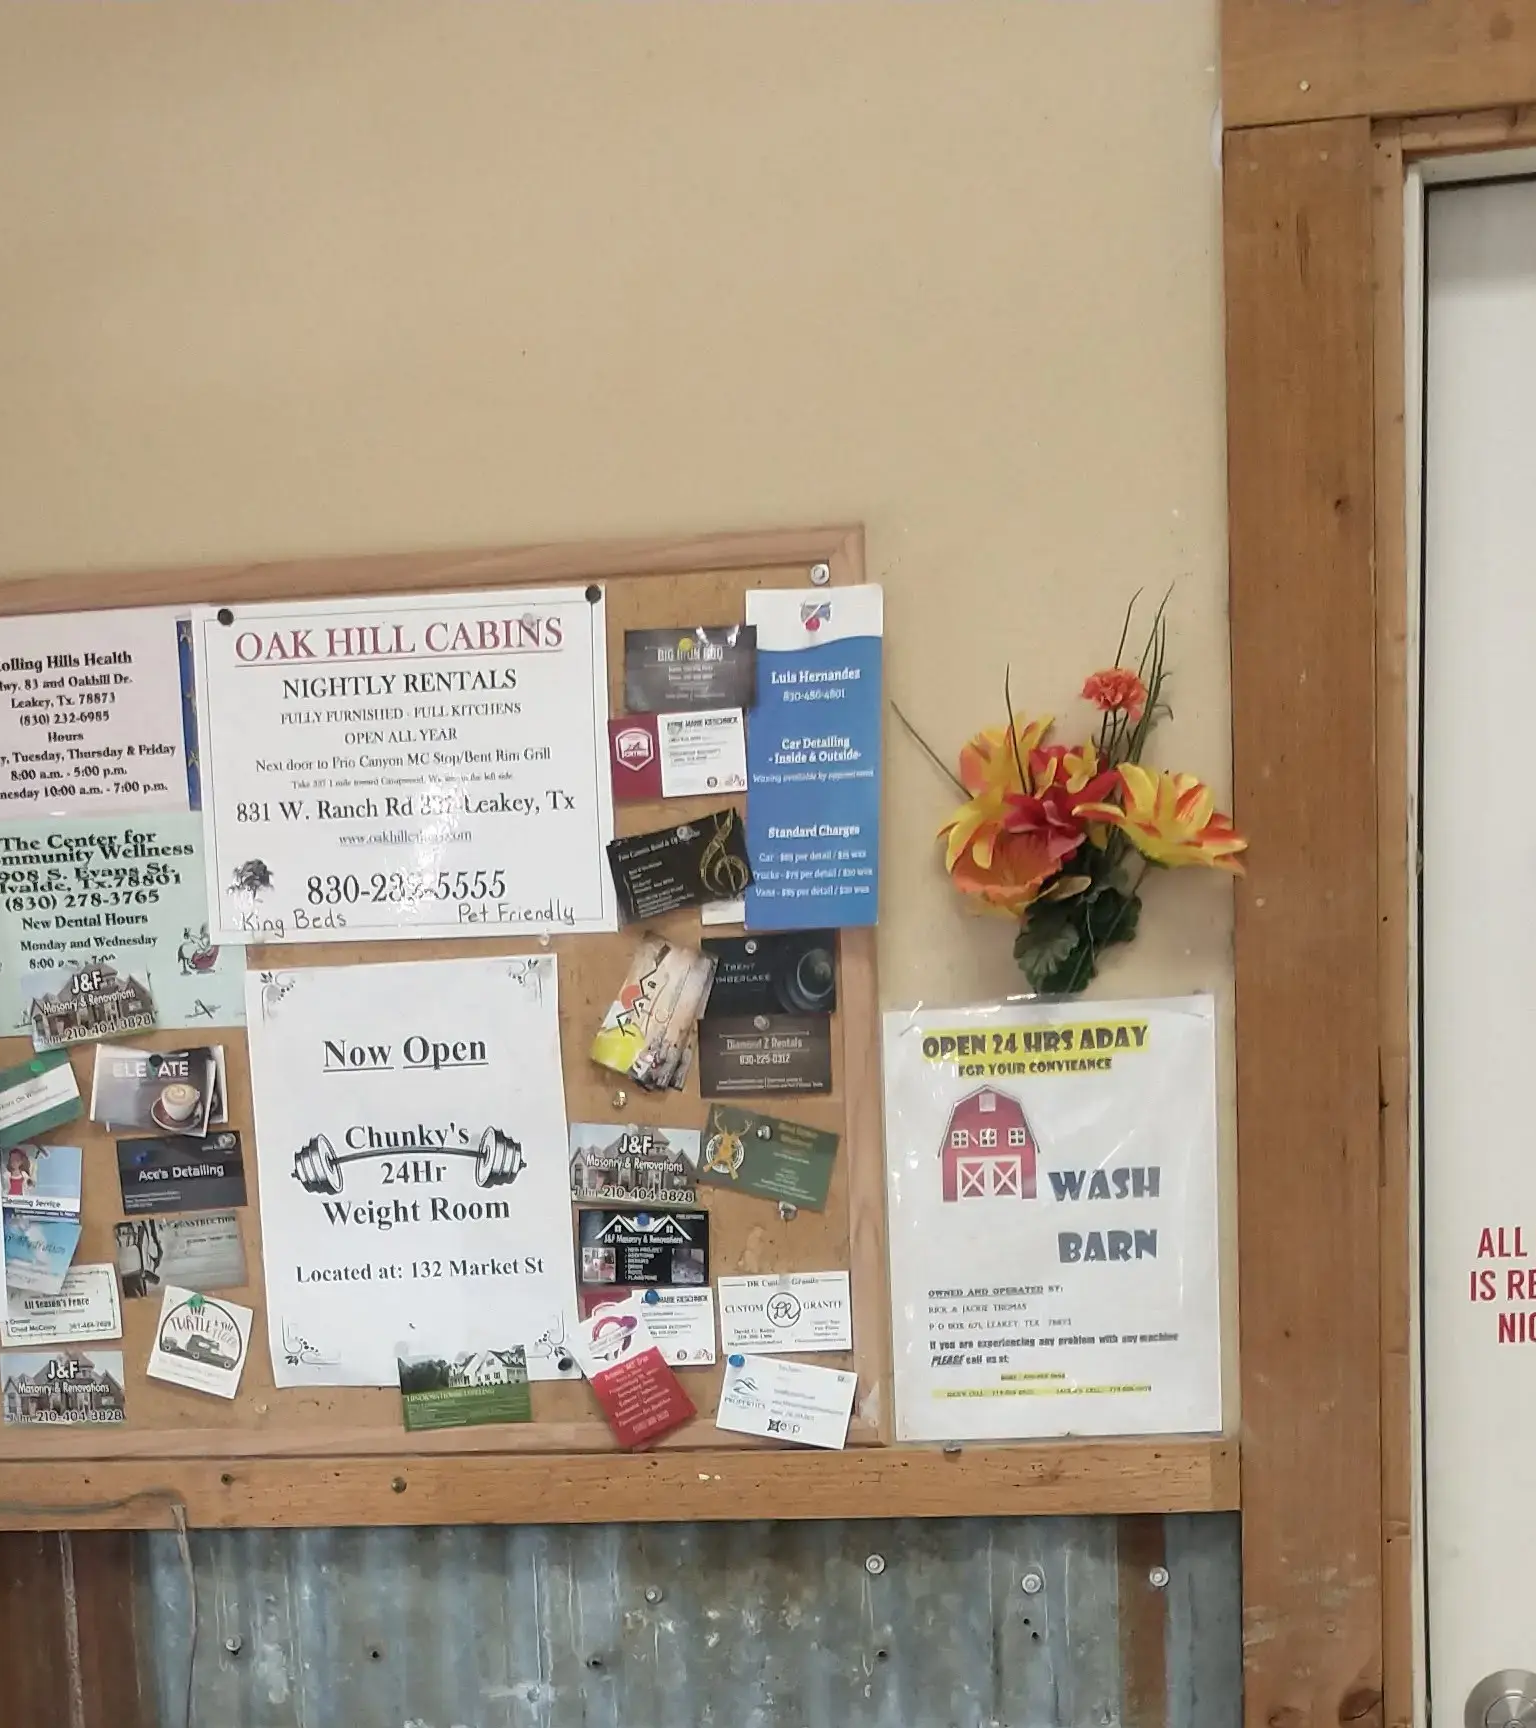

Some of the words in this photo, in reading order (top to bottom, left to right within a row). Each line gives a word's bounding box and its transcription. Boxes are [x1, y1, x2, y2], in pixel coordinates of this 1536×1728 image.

[235, 632, 317, 662] OAK
[326, 625, 416, 657] HILL
[425, 617, 563, 652] CABINS
[47, 654, 80, 668] Hills
[84, 651, 132, 666] Health
[24, 678, 38, 690] 83
[43, 676, 64, 688] and
[68, 674, 110, 687] Oakhill
[114, 673, 132, 684] Dr.
[282, 674, 396, 700] NIGHTLY
[404, 669, 517, 693] RENTALS
[771, 671, 797, 684] Luis
[799, 667, 860, 683] Hernandez
[11, 697, 54, 710] Leakey,
[56, 695, 75, 706] Tx.
[79, 692, 116, 704] 78873
[20, 714, 50, 726] (830)
[54, 711, 110, 724] 232-6985
[48, 730, 84, 742] Hours
[344, 731, 384, 745] OPEN
[388, 731, 412, 743] ALL
[414, 728, 458, 742] YEAR
[781, 738, 800, 750] Car
[803, 736, 850, 748] Detailing
[236, 802, 270, 822] 831
[279, 801, 311, 821] W.
[318, 798, 378, 819] Ranch
[386, 797, 414, 817] Rd
[465, 792, 540, 815] Leakey,
[546, 790, 576, 810] Tx
[0, 837, 41, 852] The
[48, 834, 116, 850] Center
[124, 829, 156, 844] for
[768, 826, 816, 839] Standard
[818, 824, 860, 837] Charges
[103, 843, 194, 860] Wellness
[48, 868, 68, 881] S.
[76, 866, 140, 881] Evans
[146, 862, 176, 876] St.
[5, 893, 58, 912] (830)
[65, 890, 160, 908] 278-3765
[22, 916, 52, 930] New
[56, 914, 101, 928] Dental
[105, 912, 148, 926] Hours
[238, 913, 284, 936] King
[294, 909, 347, 928] Beds
[458, 903, 489, 924] Pet
[498, 898, 576, 924] Friendly
[20, 938, 68, 954] Monday
[70, 938, 91, 950] and
[94, 934, 158, 950] Wednesday
[923, 1034, 987, 1058] OPEN
[992, 1033, 1017, 1054] 24
[1023, 1029, 1074, 1053] HRS
[1079, 1025, 1149, 1051] ADAY
[323, 1038, 392, 1067] Now
[403, 1035, 488, 1070] Open
[958, 1064, 985, 1077] FOR
[989, 1062, 1026, 1075] YOUR
[345, 1123, 469, 1151] Chunky's
[618, 1134, 654, 1155] J&F
[172, 1162, 225, 1179] Detailing
[380, 1160, 447, 1185] 24Hr
[586, 1155, 622, 1172] Masonry
[633, 1160, 683, 1173] Renovations
[1047, 1167, 1161, 1202] WASH
[323, 1199, 421, 1231] Weight
[431, 1198, 510, 1223] Room
[1058, 1230, 1158, 1264] BARN
[1477, 1226, 1527, 1258] ALL
[297, 1264, 371, 1284] Located
[378, 1262, 403, 1281] at:
[411, 1260, 442, 1279] 132
[449, 1260, 519, 1277] Market
[525, 1257, 544, 1274] St
[928, 1289, 963, 1298] OWNED
[993, 1286, 1044, 1297] OPERATED
[1470, 1270, 1496, 1301] IS
[48, 1358, 80, 1380] J&F
[18, 1382, 54, 1395] Masonry
[63, 1382, 110, 1394] Renovations
